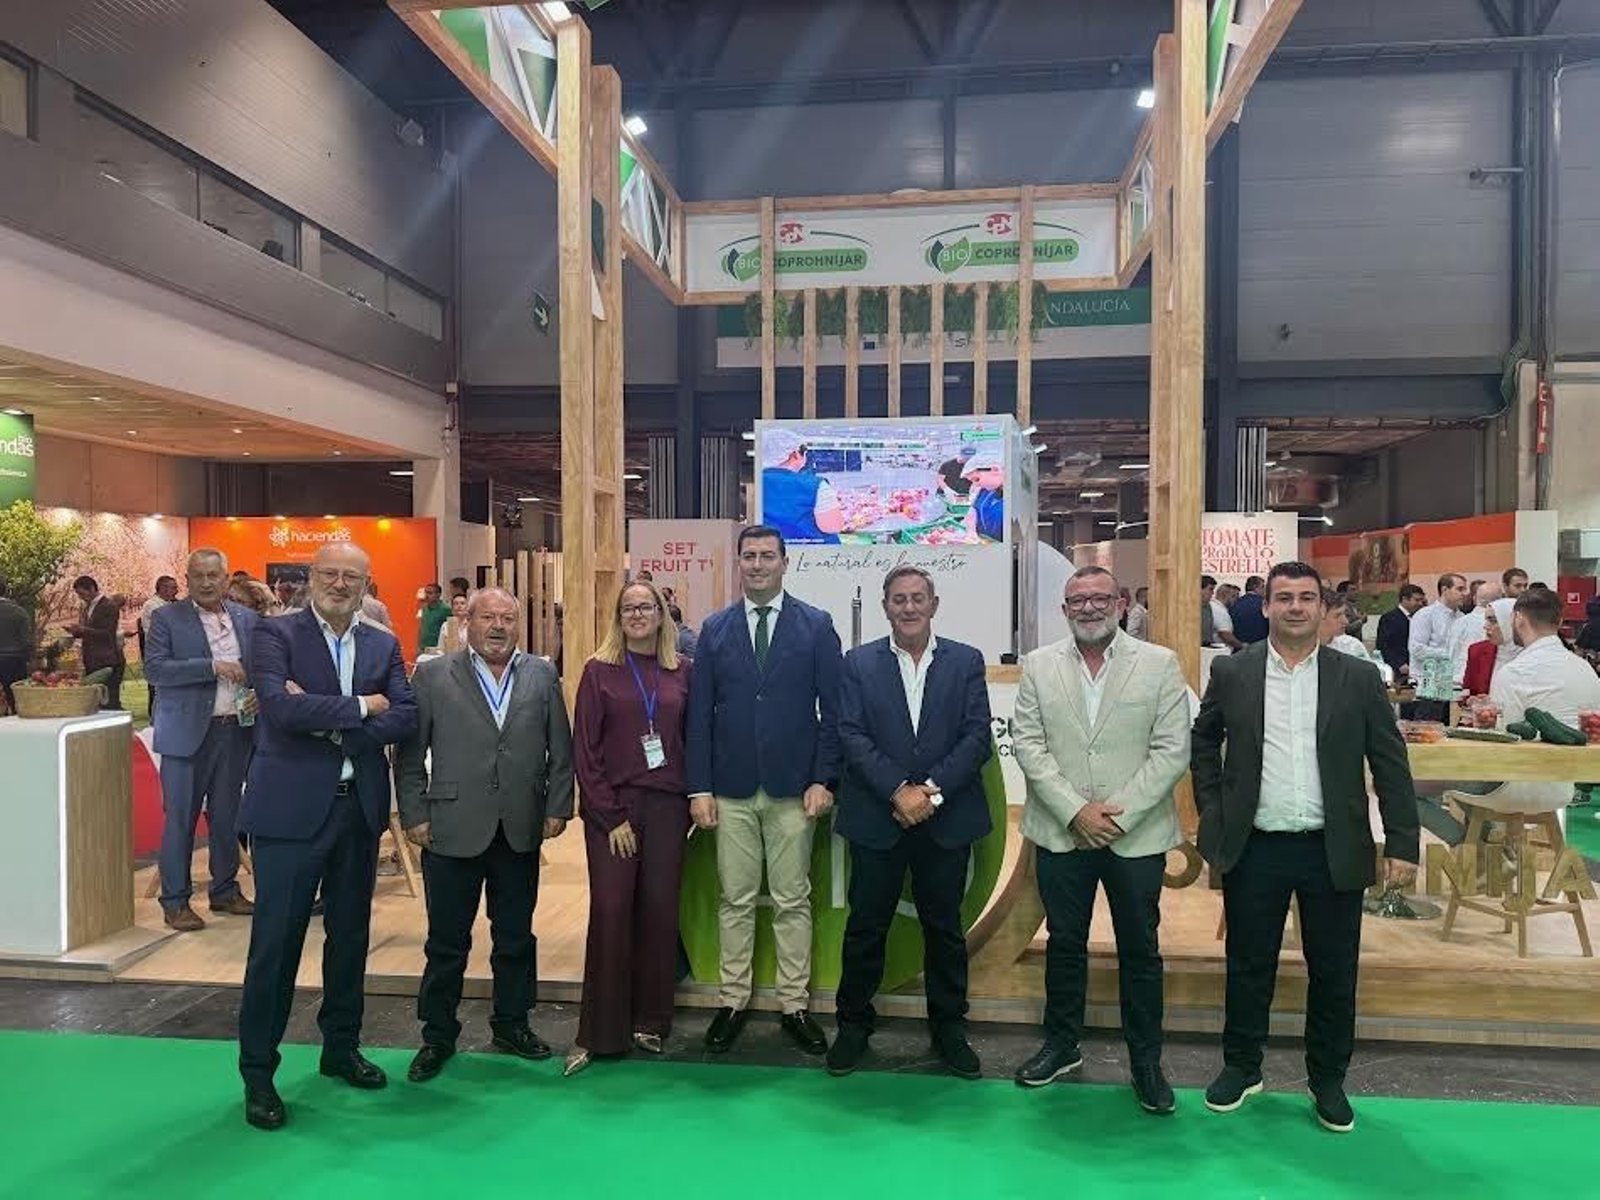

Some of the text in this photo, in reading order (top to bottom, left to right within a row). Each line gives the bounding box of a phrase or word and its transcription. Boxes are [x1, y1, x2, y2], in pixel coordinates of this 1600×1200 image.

[942, 243, 1073, 261] BIO COPRONÍJAR
[290, 529, 351, 542] haciendas
[1202, 528, 1273, 546] TOMATE
[663, 541, 697, 555] SET
[641, 559, 692, 572] FRUIT
[815, 551, 872, 572] natural
[875, 557, 891, 572] es
